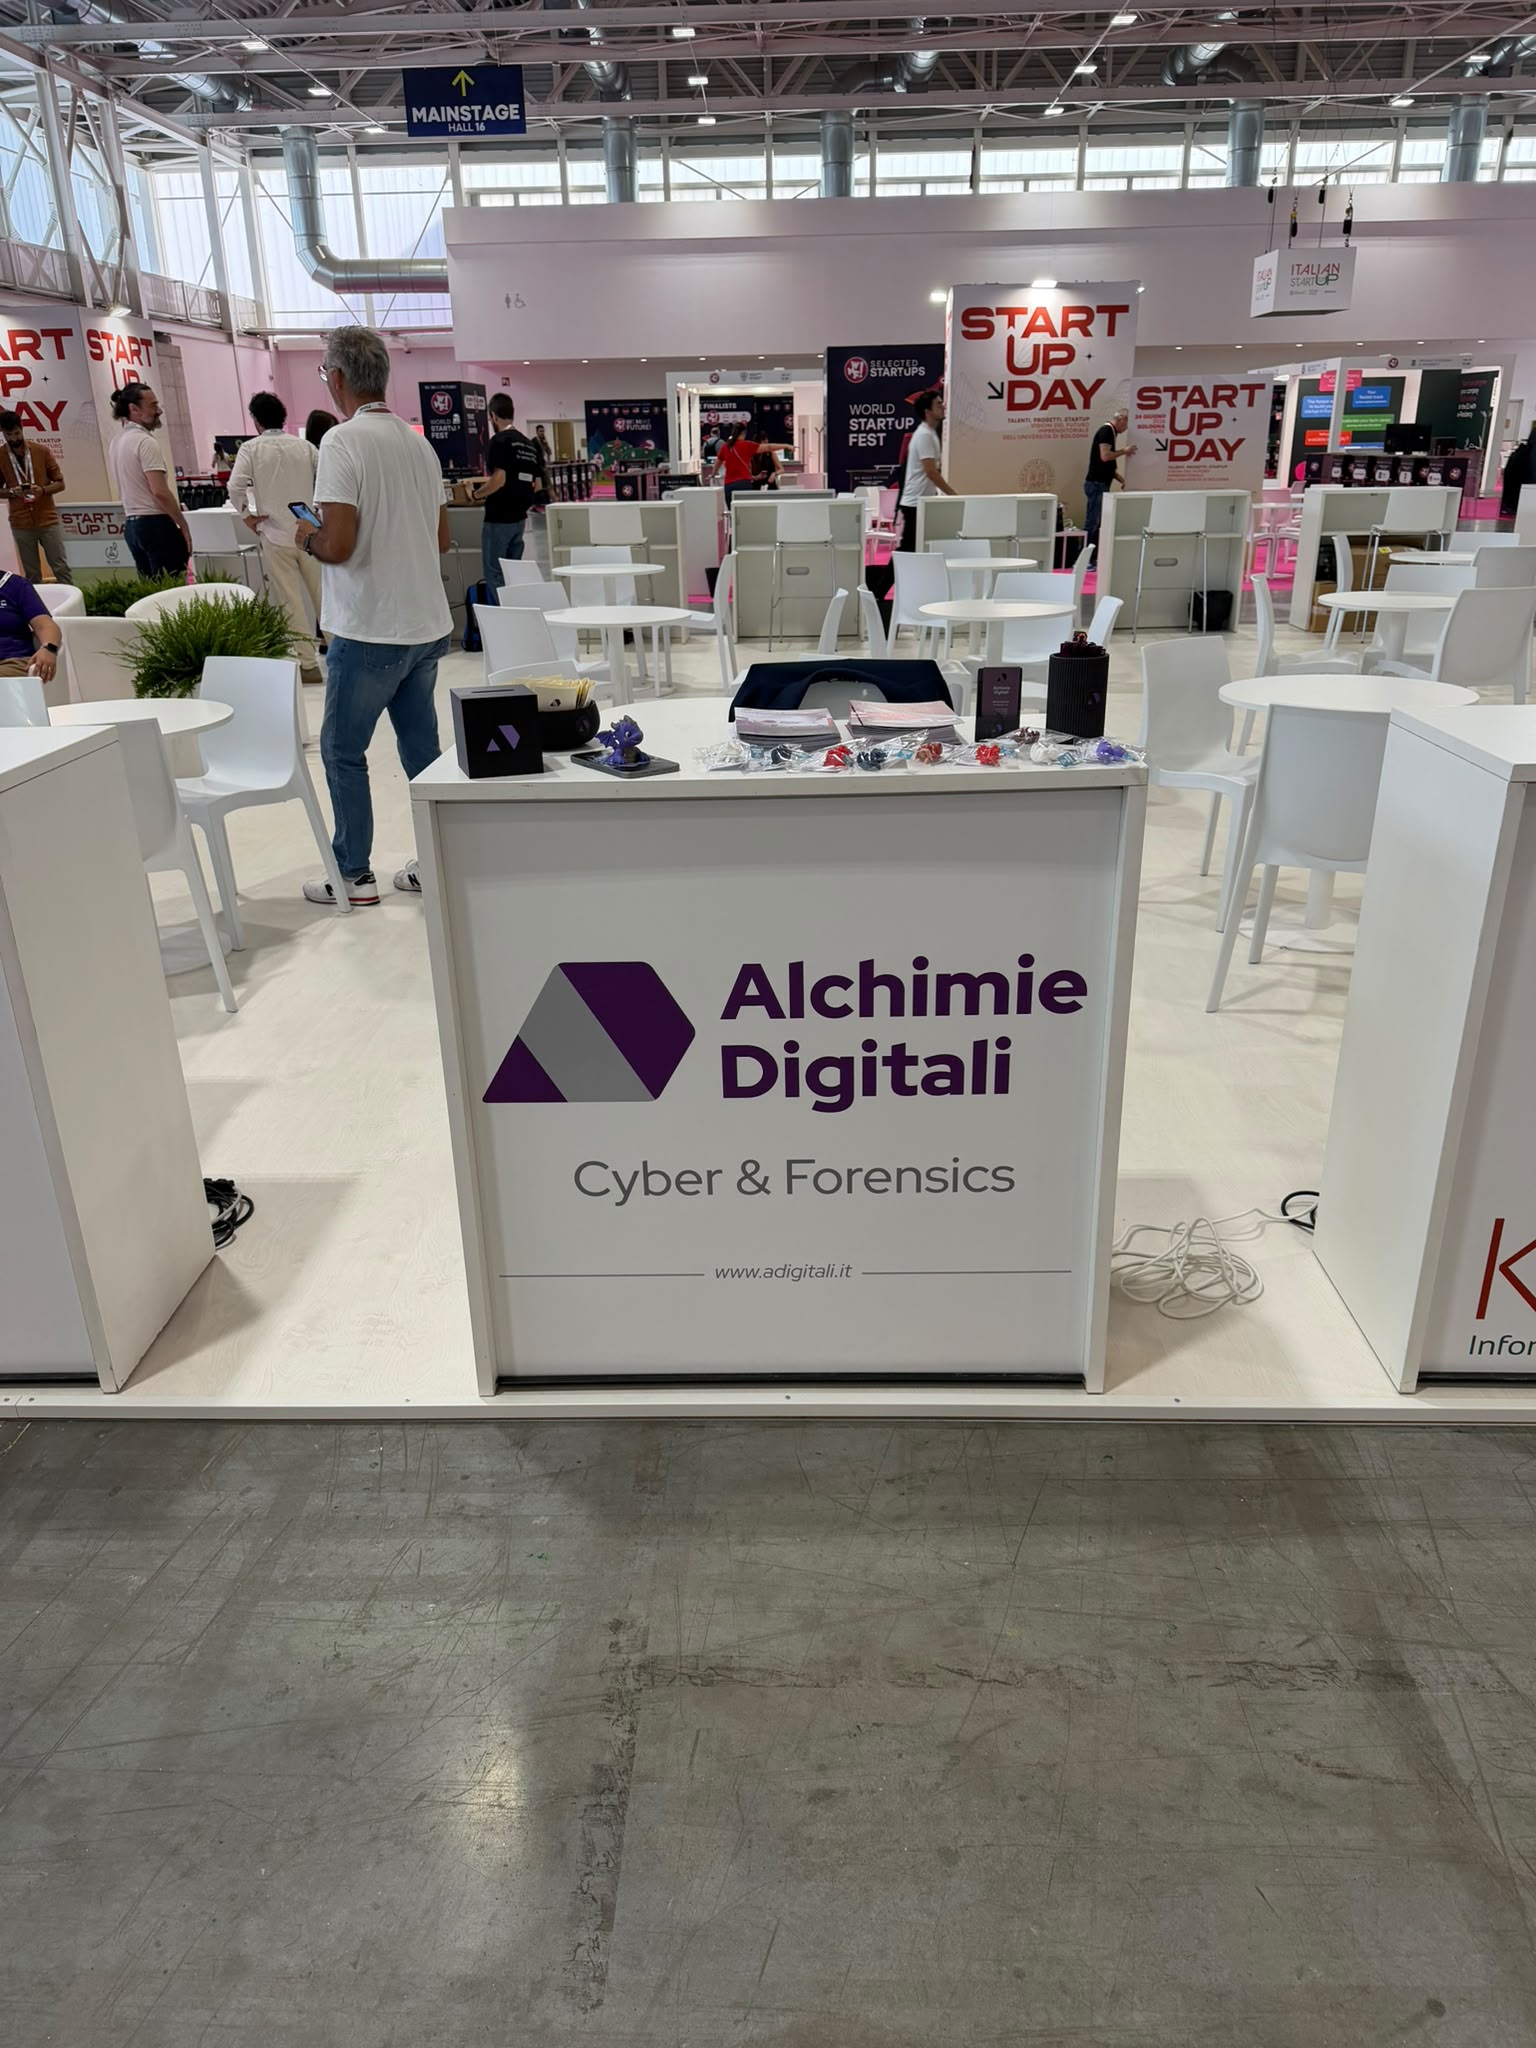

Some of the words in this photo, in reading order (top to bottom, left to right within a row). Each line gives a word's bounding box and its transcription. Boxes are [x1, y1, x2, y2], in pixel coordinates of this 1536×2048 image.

[412, 104, 520, 123] MAINSTAGE
[448, 123, 474, 132] HALL
[475, 122, 486, 131] 16
[1291, 263, 1341, 275] ITALIAN
[961, 305, 1129, 340] START
[86, 329, 153, 367] START
[1006, 334, 1076, 376] UP
[870, 367, 926, 377] STARTUPS
[1006, 378, 1107, 412] DAY
[1136, 383, 1266, 411] START
[0, 401, 68, 432] AY
[849, 404, 895, 415] WORLD
[1169, 406, 1223, 436] UP
[849, 417, 915, 431] STARTUP
[848, 433, 887, 446] FEST
[1168, 438, 1246, 462] DAY
[61, 512, 114, 524] START
[78, 522, 100, 535] UP
[719, 953, 1088, 1019] Alchimie
[720, 1035, 1012, 1114] Digitali
[573, 1159, 723, 1207] Cyber
[736, 1159, 772, 1196] &
[786, 1157, 1016, 1195] Forensics
[715, 1263, 853, 1283] www.adigitali.it
